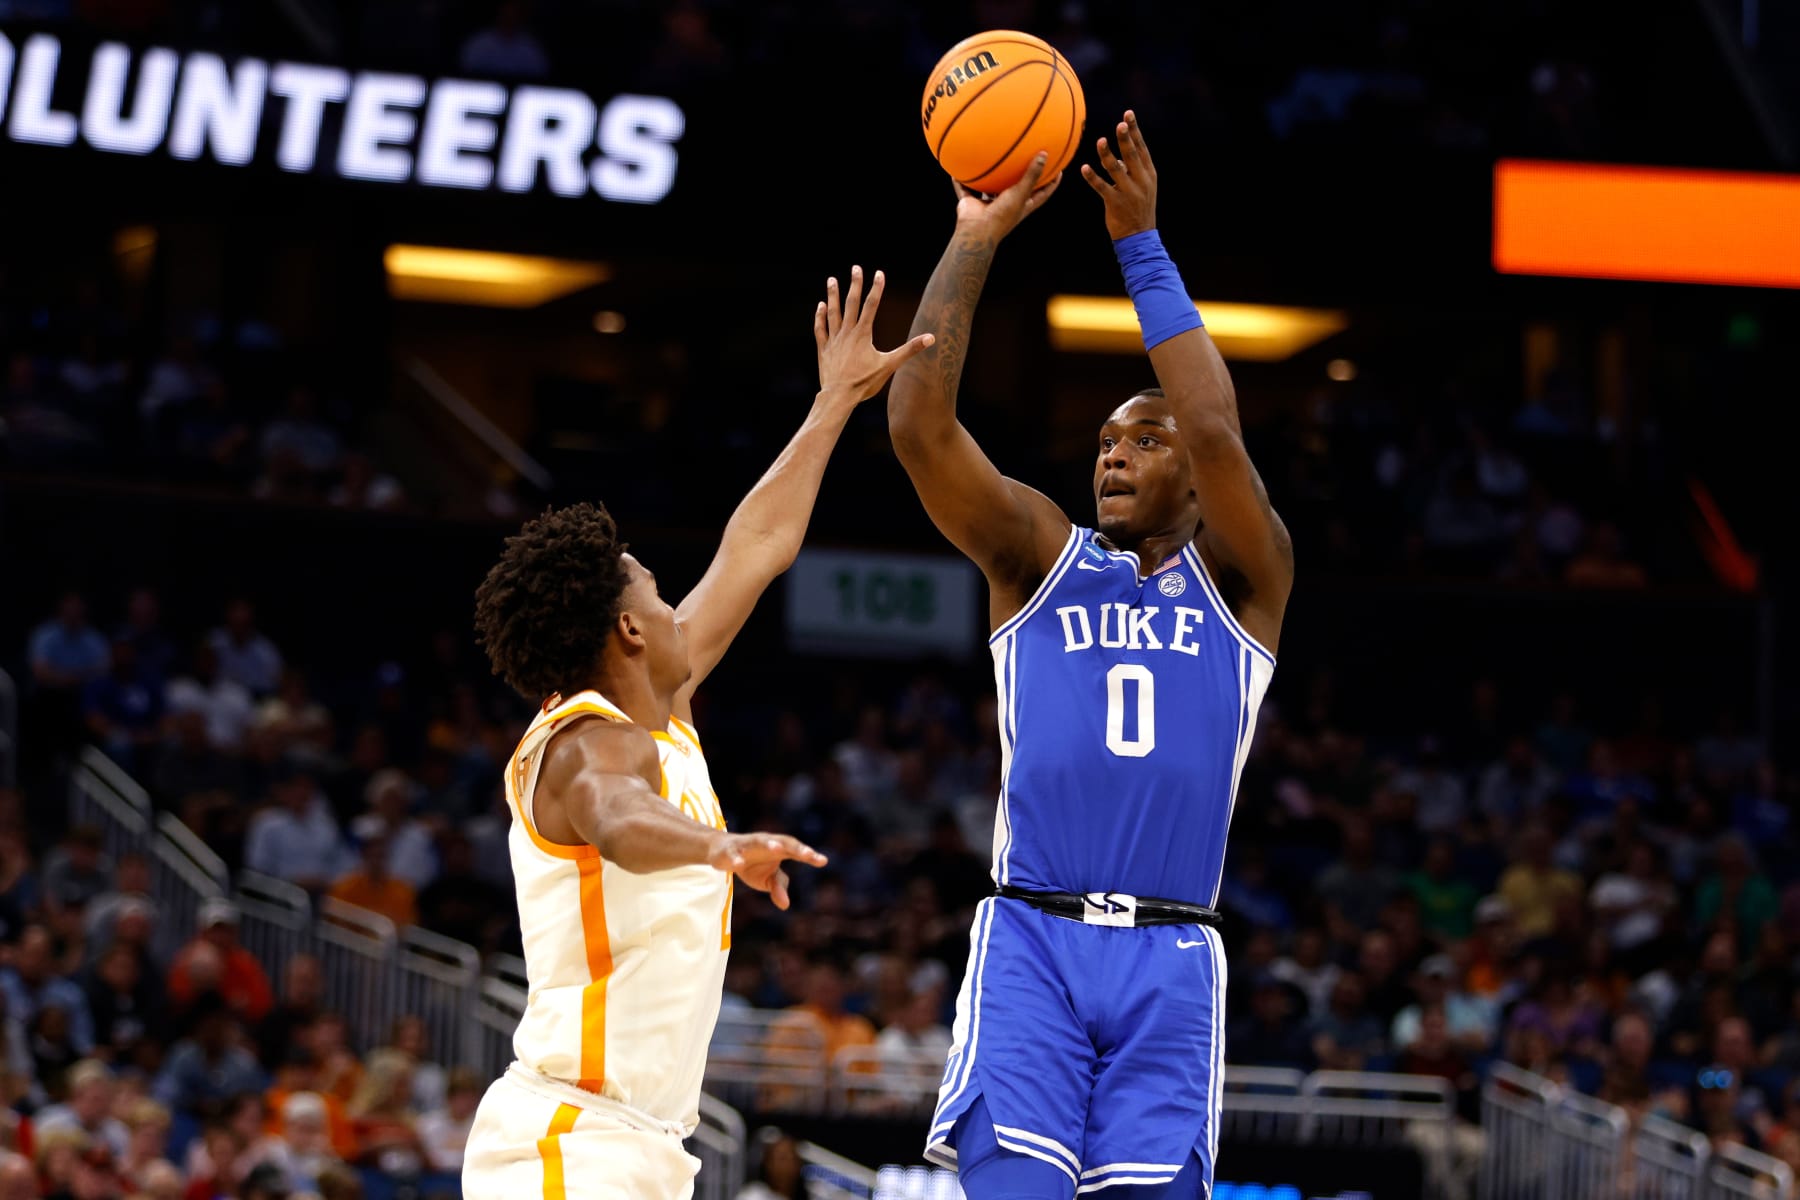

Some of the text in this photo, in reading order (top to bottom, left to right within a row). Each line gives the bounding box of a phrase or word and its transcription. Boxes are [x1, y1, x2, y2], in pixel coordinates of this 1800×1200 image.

[0, 30, 686, 205] LUNTEERS
[923, 50, 1000, 130] Wilson
[1056, 602, 1204, 657] DUKE
[1105, 663, 1156, 758] 0
